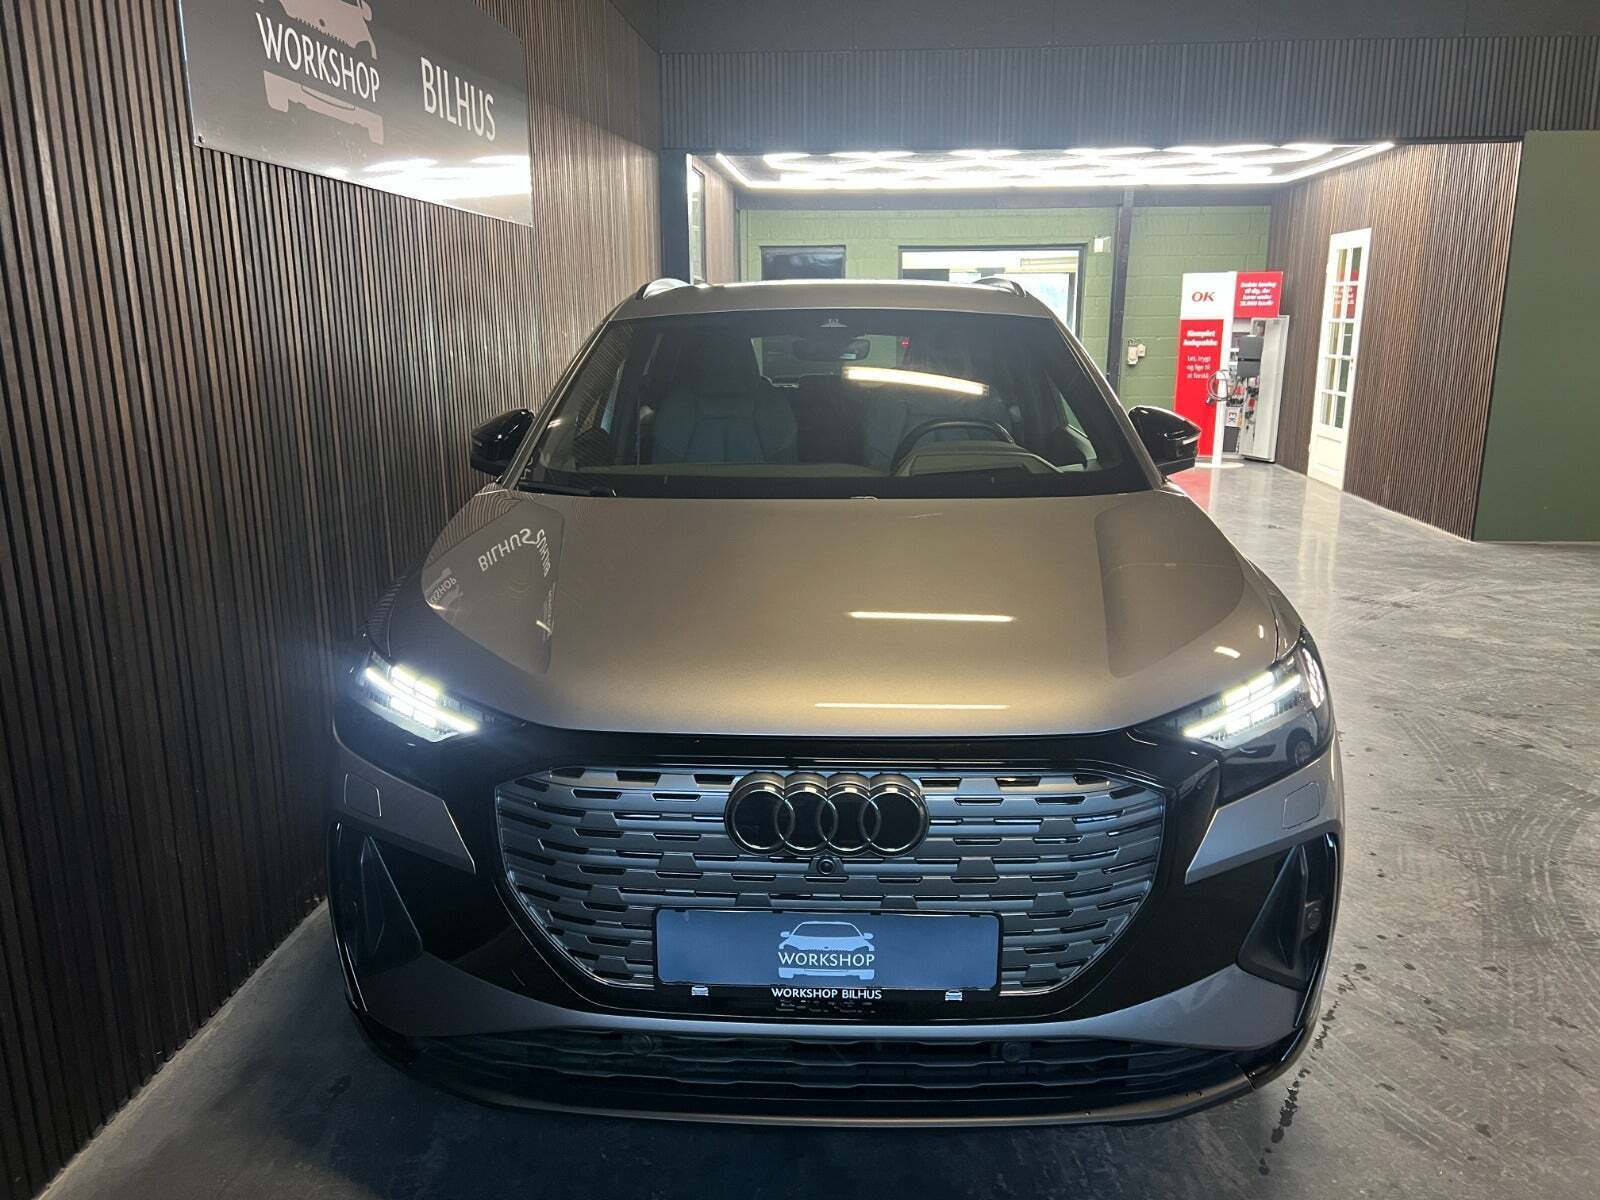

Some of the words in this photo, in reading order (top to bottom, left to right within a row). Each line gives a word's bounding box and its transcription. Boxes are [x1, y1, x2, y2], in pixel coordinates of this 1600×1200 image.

[255, 12, 380, 103] WORKSHOP
[420, 56, 496, 142] BILHUS
[1191, 291, 1215, 302] OK
[778, 951, 875, 967] WORKSHOP
[771, 988, 838, 998] WORKSHOP
[841, 989, 882, 999] BILHUS
